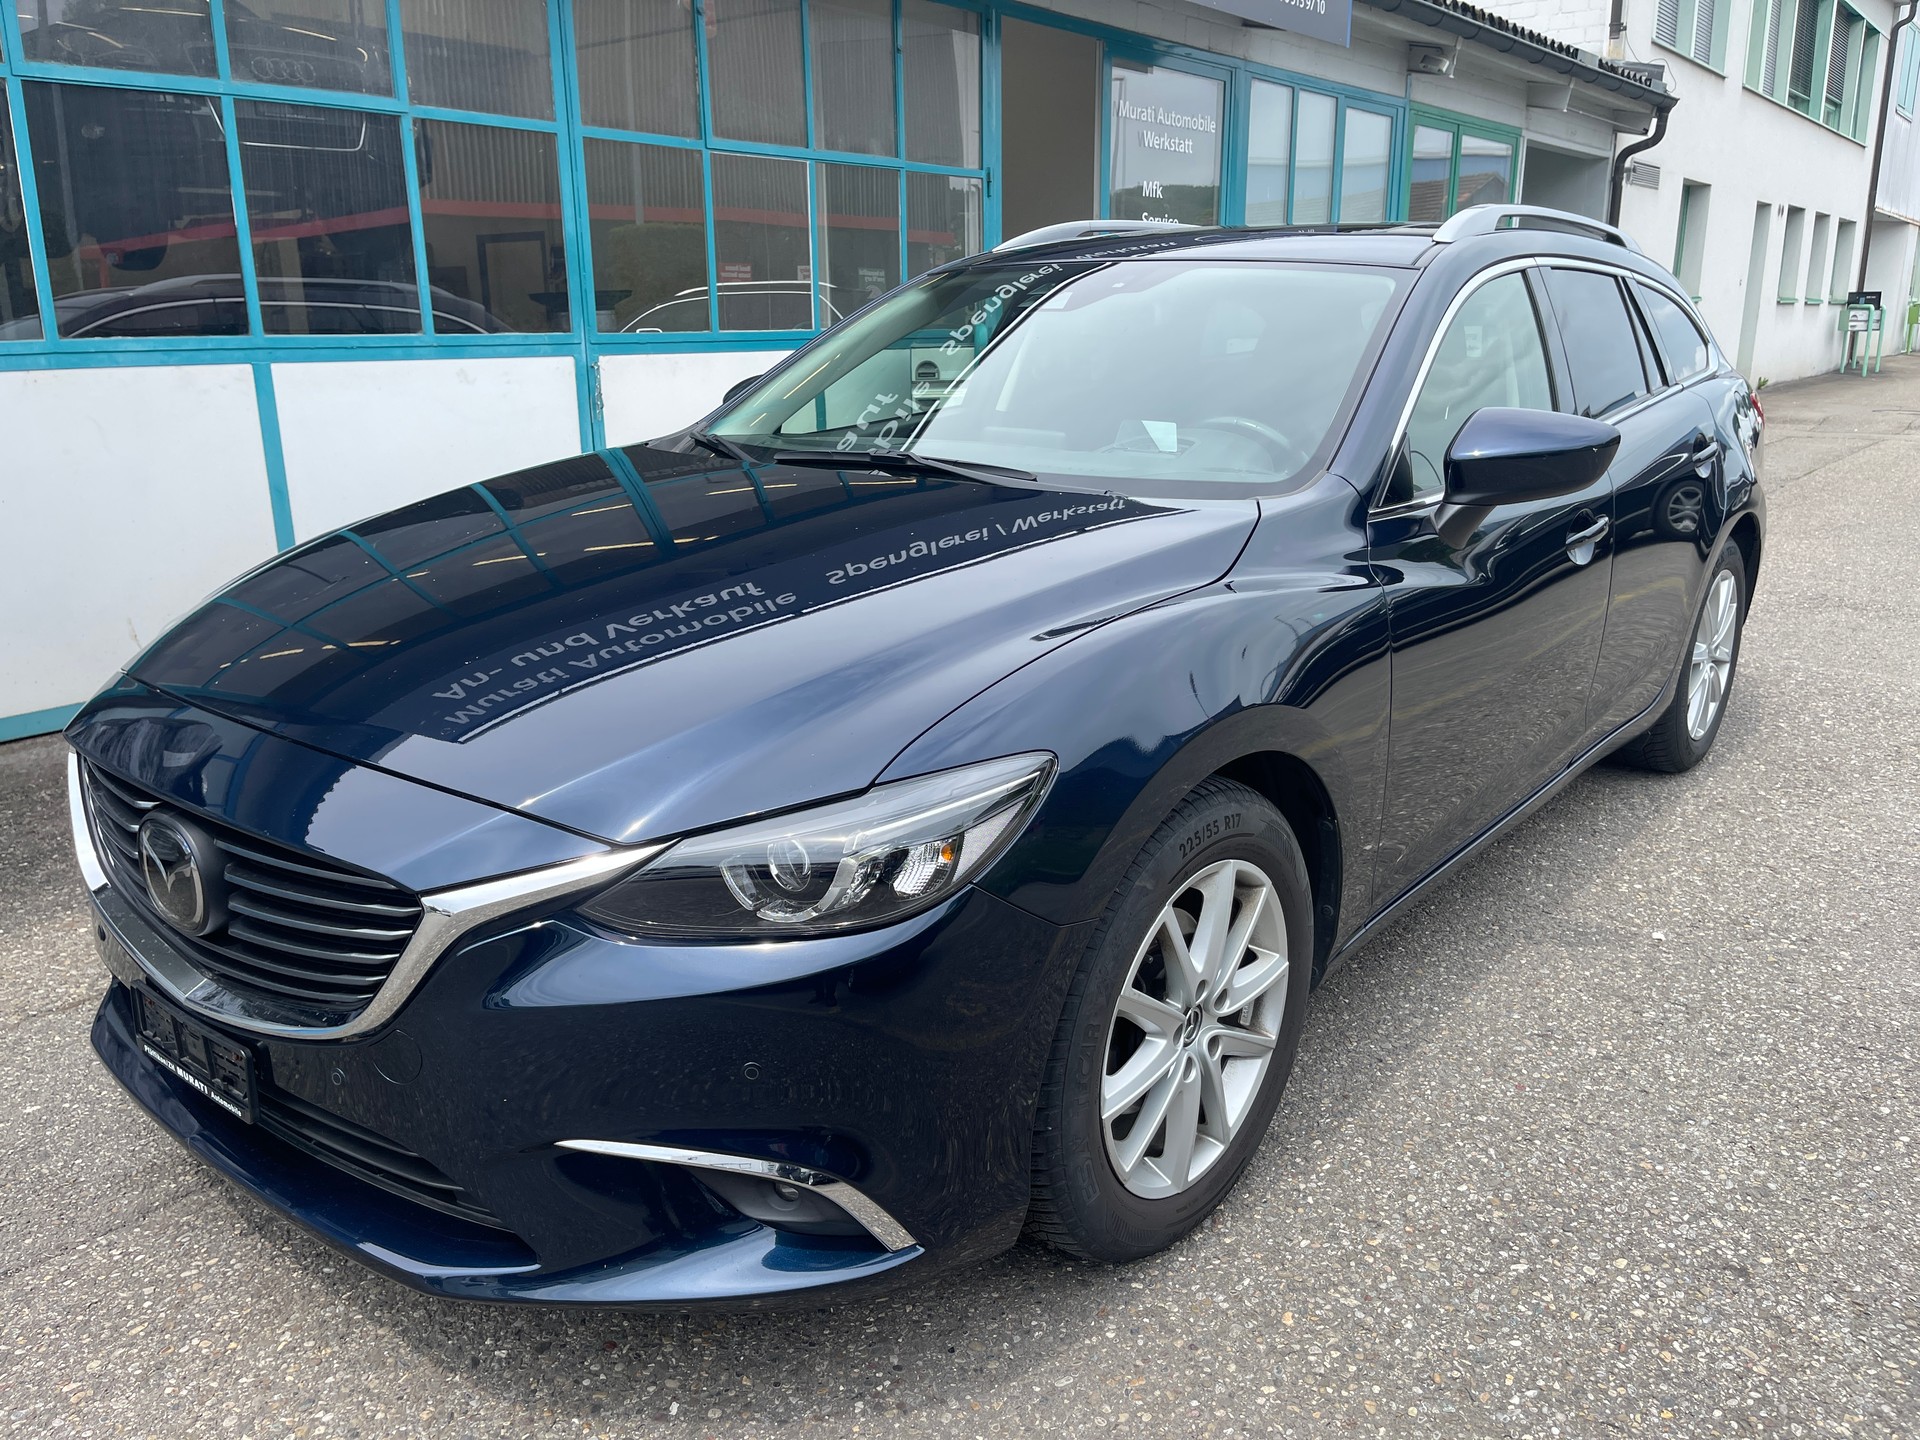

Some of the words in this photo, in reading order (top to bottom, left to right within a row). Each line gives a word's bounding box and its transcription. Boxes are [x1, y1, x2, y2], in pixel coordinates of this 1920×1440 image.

[1119, 100, 1155, 123] Murati
[1157, 107, 1217, 133] Automobile
[1143, 130, 1193, 154] Werkstatt
[1142, 181, 1163, 199] Mfk
[1179, 820, 1220, 859] 225/55
[1224, 813, 1242, 831] R17
[176, 1066, 209, 1095] MURATI
